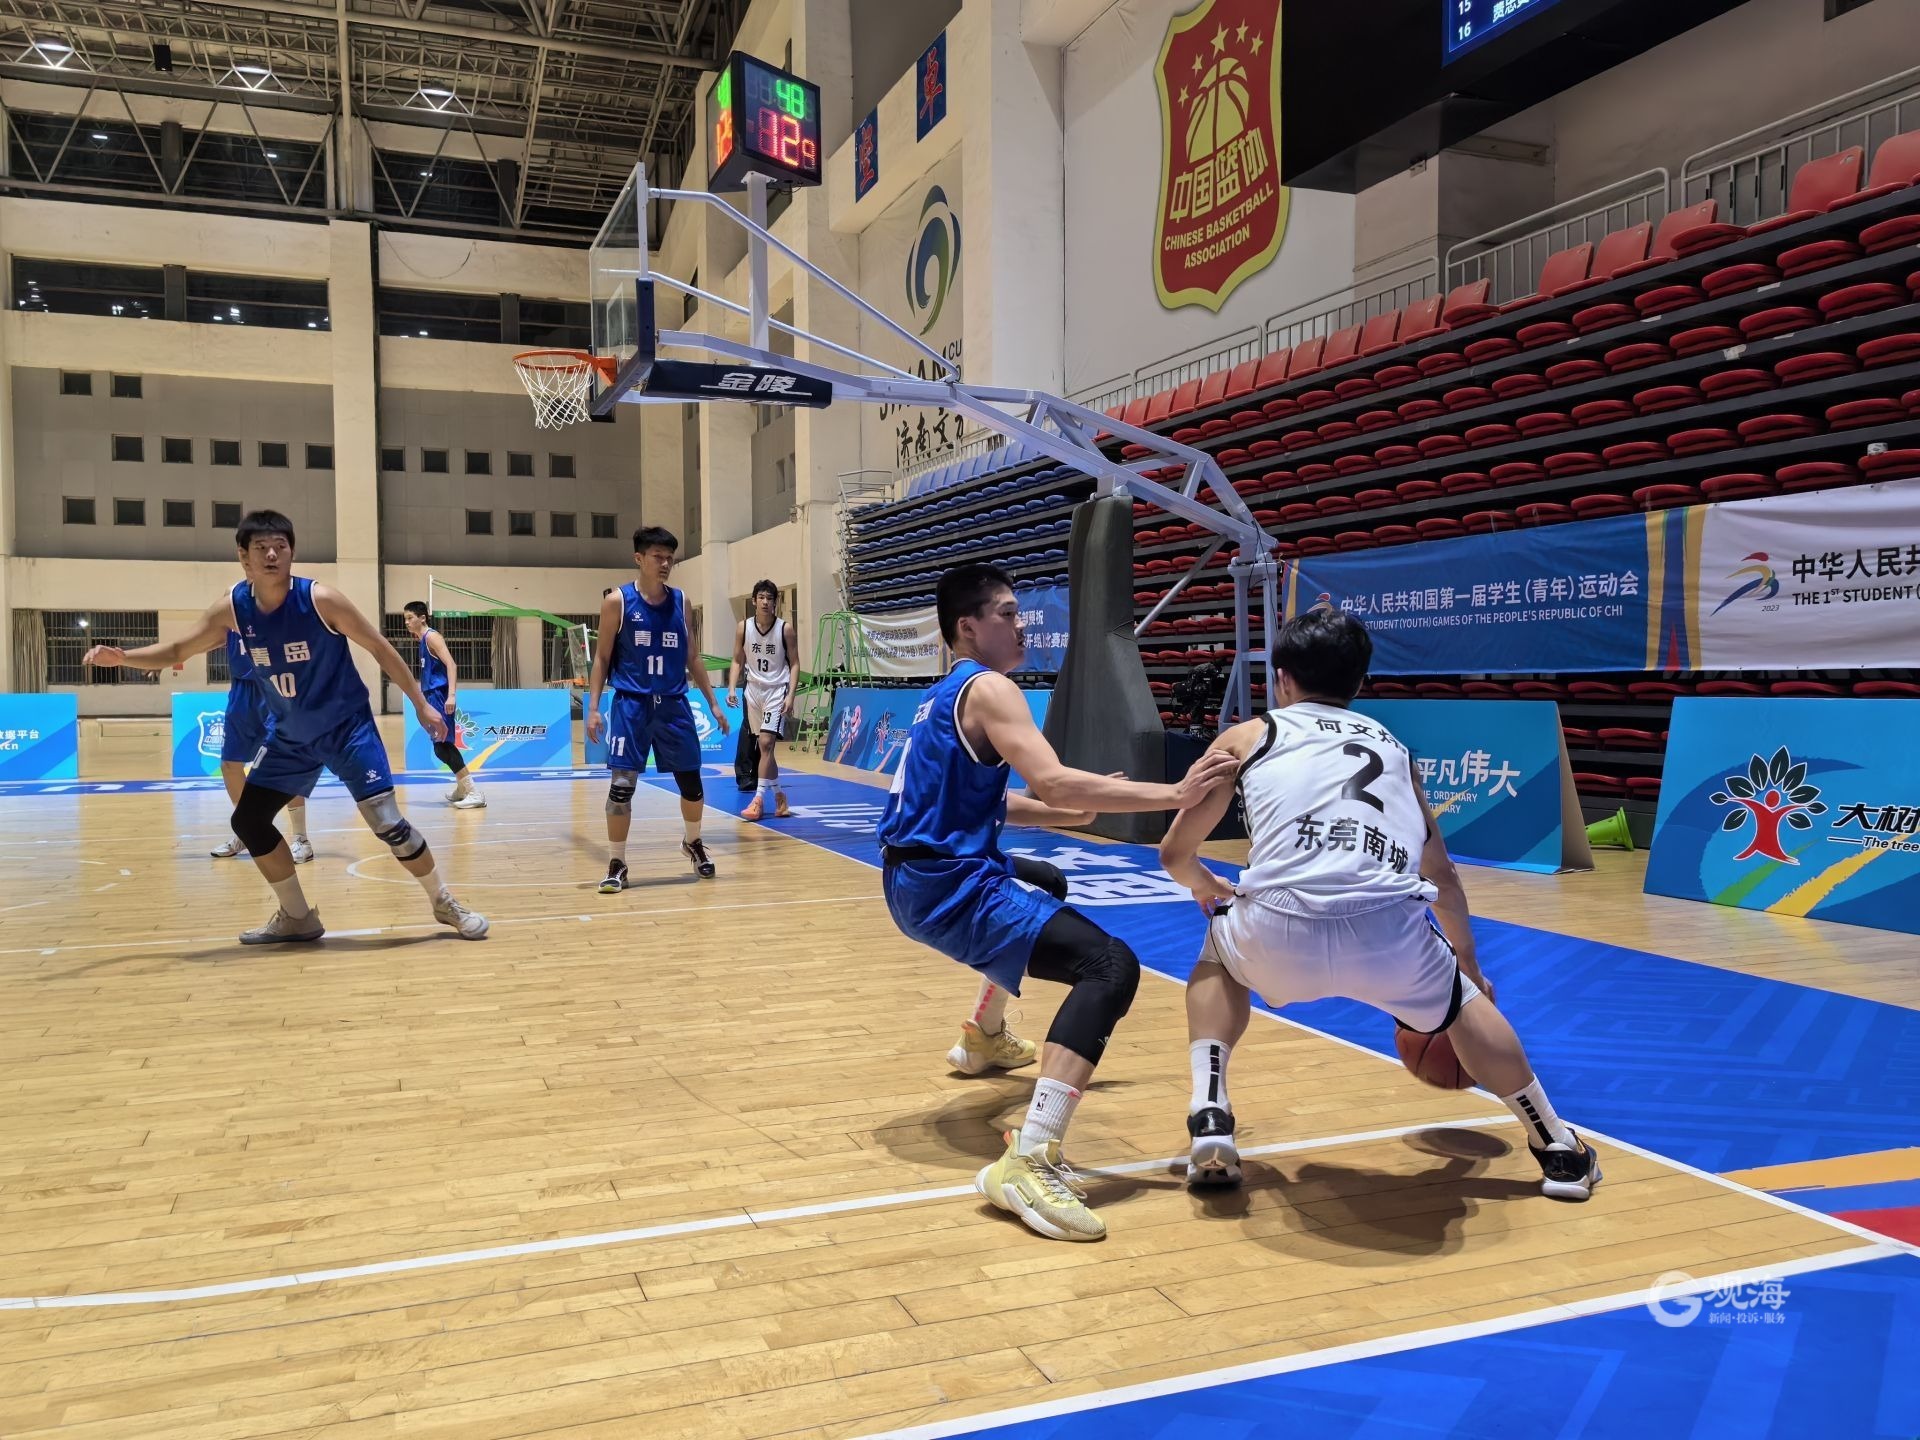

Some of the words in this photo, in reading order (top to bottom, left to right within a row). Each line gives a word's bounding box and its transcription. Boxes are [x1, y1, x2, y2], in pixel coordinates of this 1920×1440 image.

[1458, 21, 1472, 41] 16
[1169, 127, 1269, 223] 中国篮协
[1164, 227, 1204, 251] CHINESE
[1206, 182, 1274, 240] BASKETBALL
[1184, 223, 1251, 269] ASSOCIATION
[717, 372, 797, 393] 金陵
[1792, 590, 1820, 606] THE
[1843, 585, 1913, 602] STUDENT
[1432, 614, 1460, 628] GAMES
[1461, 613, 1474, 626] OF
[1474, 612, 1492, 625] THE
[1493, 609, 1537, 623] PEOPLE'S
[1538, 606, 1587, 621] REPUBLIC
[1588, 605, 1603, 618] OF
[1761, 604, 1780, 612] 2023
[634, 630, 679, 649] 青岛
[751, 643, 776, 655] 东莞
[250, 640, 312, 667] 青岛
[647, 655, 664, 676] 11
[757, 658, 769, 673] 13
[269, 672, 297, 698] 10
[483, 725, 547, 736] 大树体育
[610, 736, 626, 757] 11
[1341, 743, 1385, 814] 2
[1417, 749, 1521, 798] 平凡伟大
[1294, 814, 1409, 875] 东莞南城
[1863, 836, 1889, 850] The
[1891, 839, 1920, 852] tree
